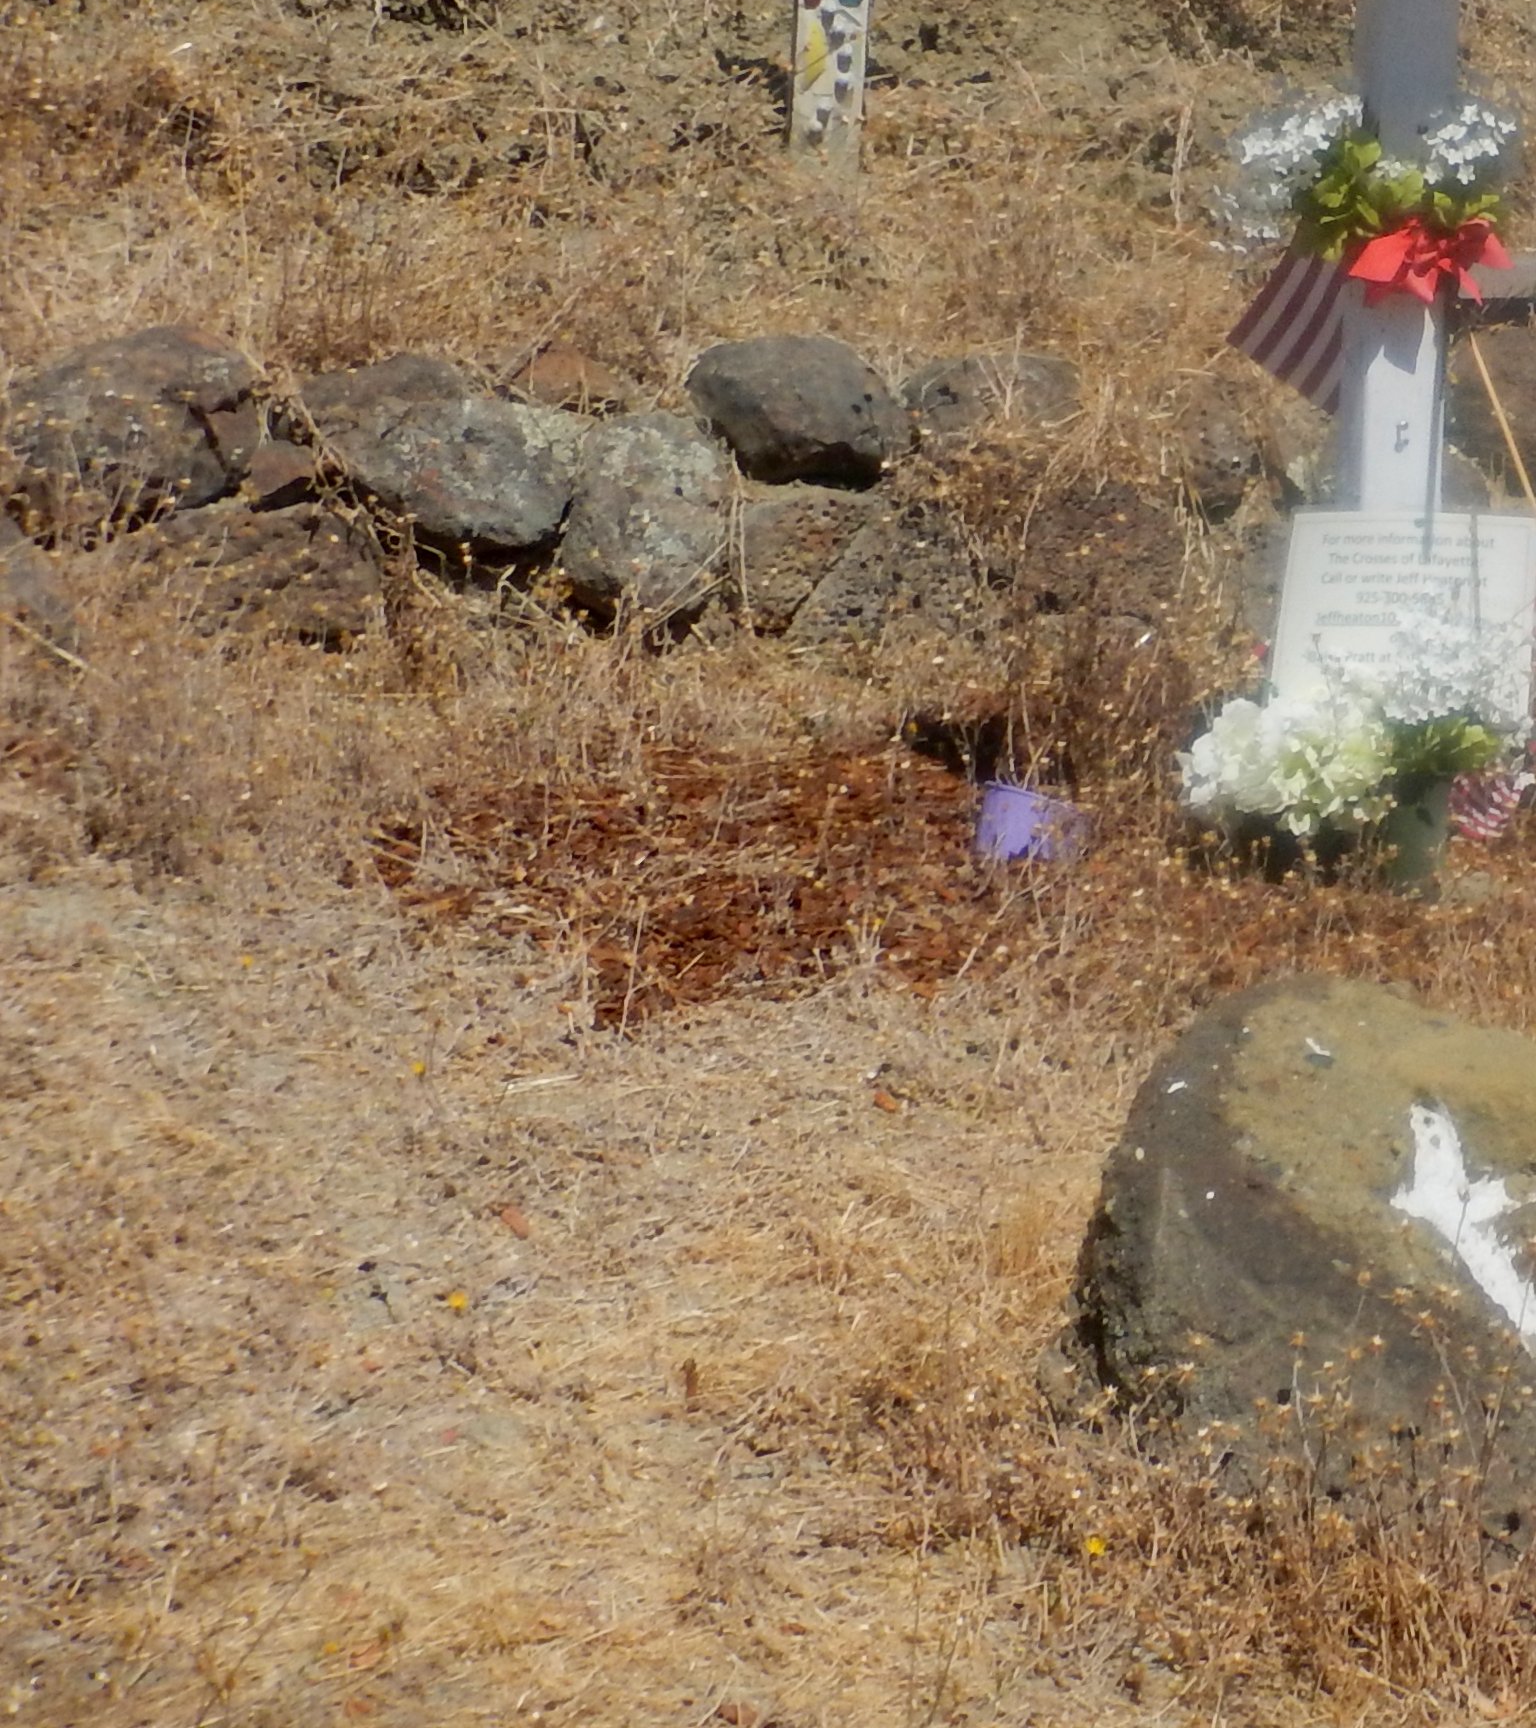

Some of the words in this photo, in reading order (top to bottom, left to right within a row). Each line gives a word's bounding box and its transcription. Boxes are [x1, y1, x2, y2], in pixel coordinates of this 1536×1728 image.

[1321, 533, 1342, 546] For
[1343, 535, 1375, 547] more
[1455, 534, 1496, 550] abut
[1328, 552, 1350, 565] The
[1352, 551, 1397, 565] Crosses
[1401, 552, 1415, 565] of
[1320, 571, 1343, 585] Call
[1344, 574, 1358, 585] or
[1360, 572, 1393, 585] write
